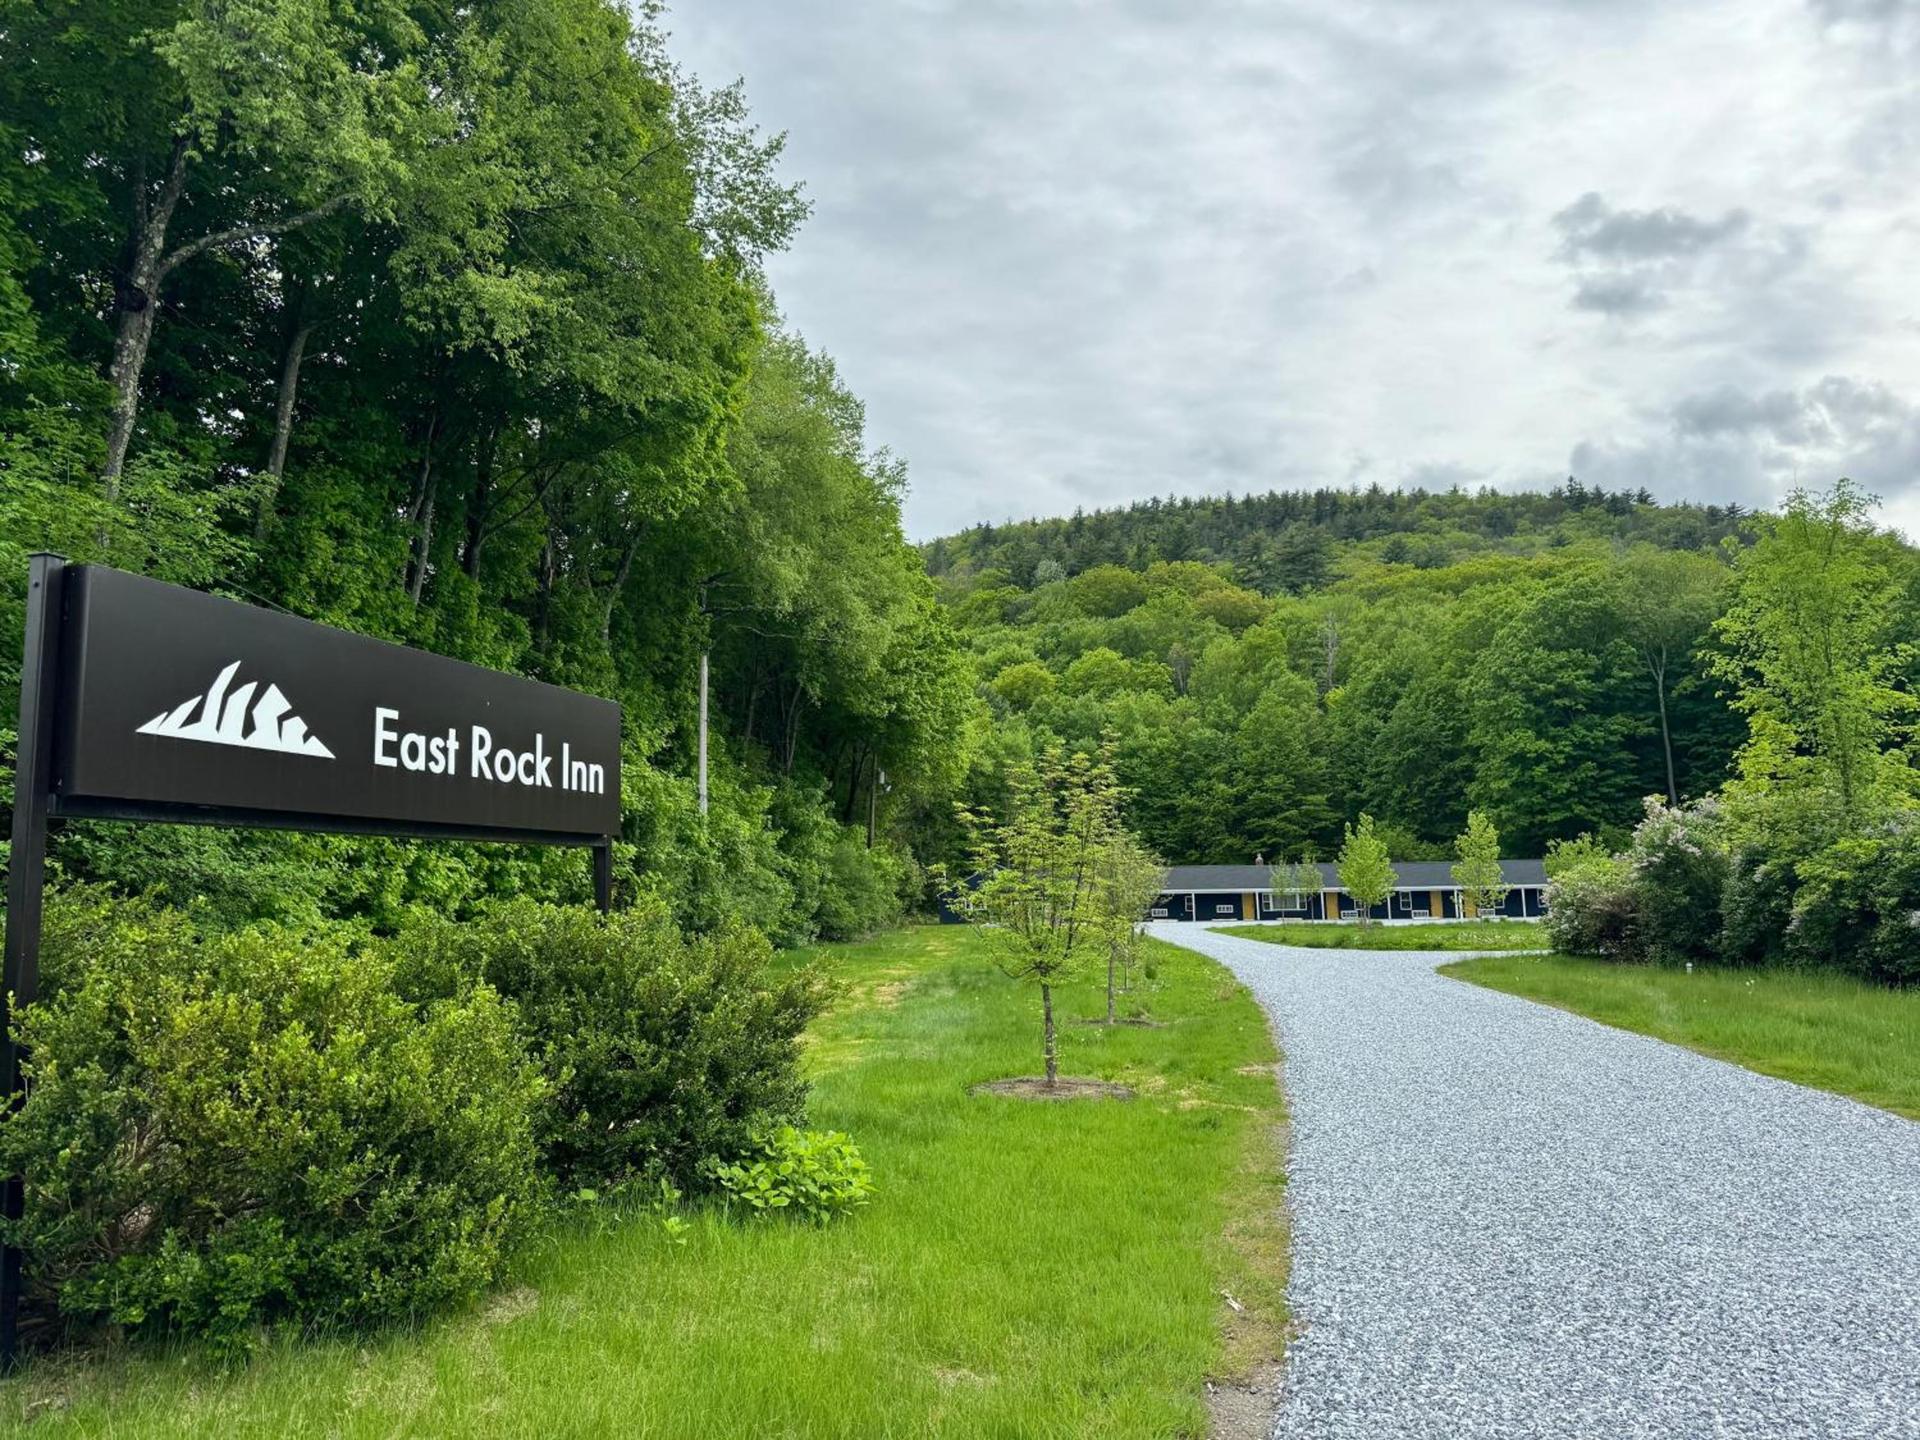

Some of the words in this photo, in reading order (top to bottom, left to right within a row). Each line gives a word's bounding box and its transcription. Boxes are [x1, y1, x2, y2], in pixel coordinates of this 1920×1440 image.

[374, 706, 459, 775] East
[471, 725, 552, 788] Rock
[562, 742, 604, 795] Inn
